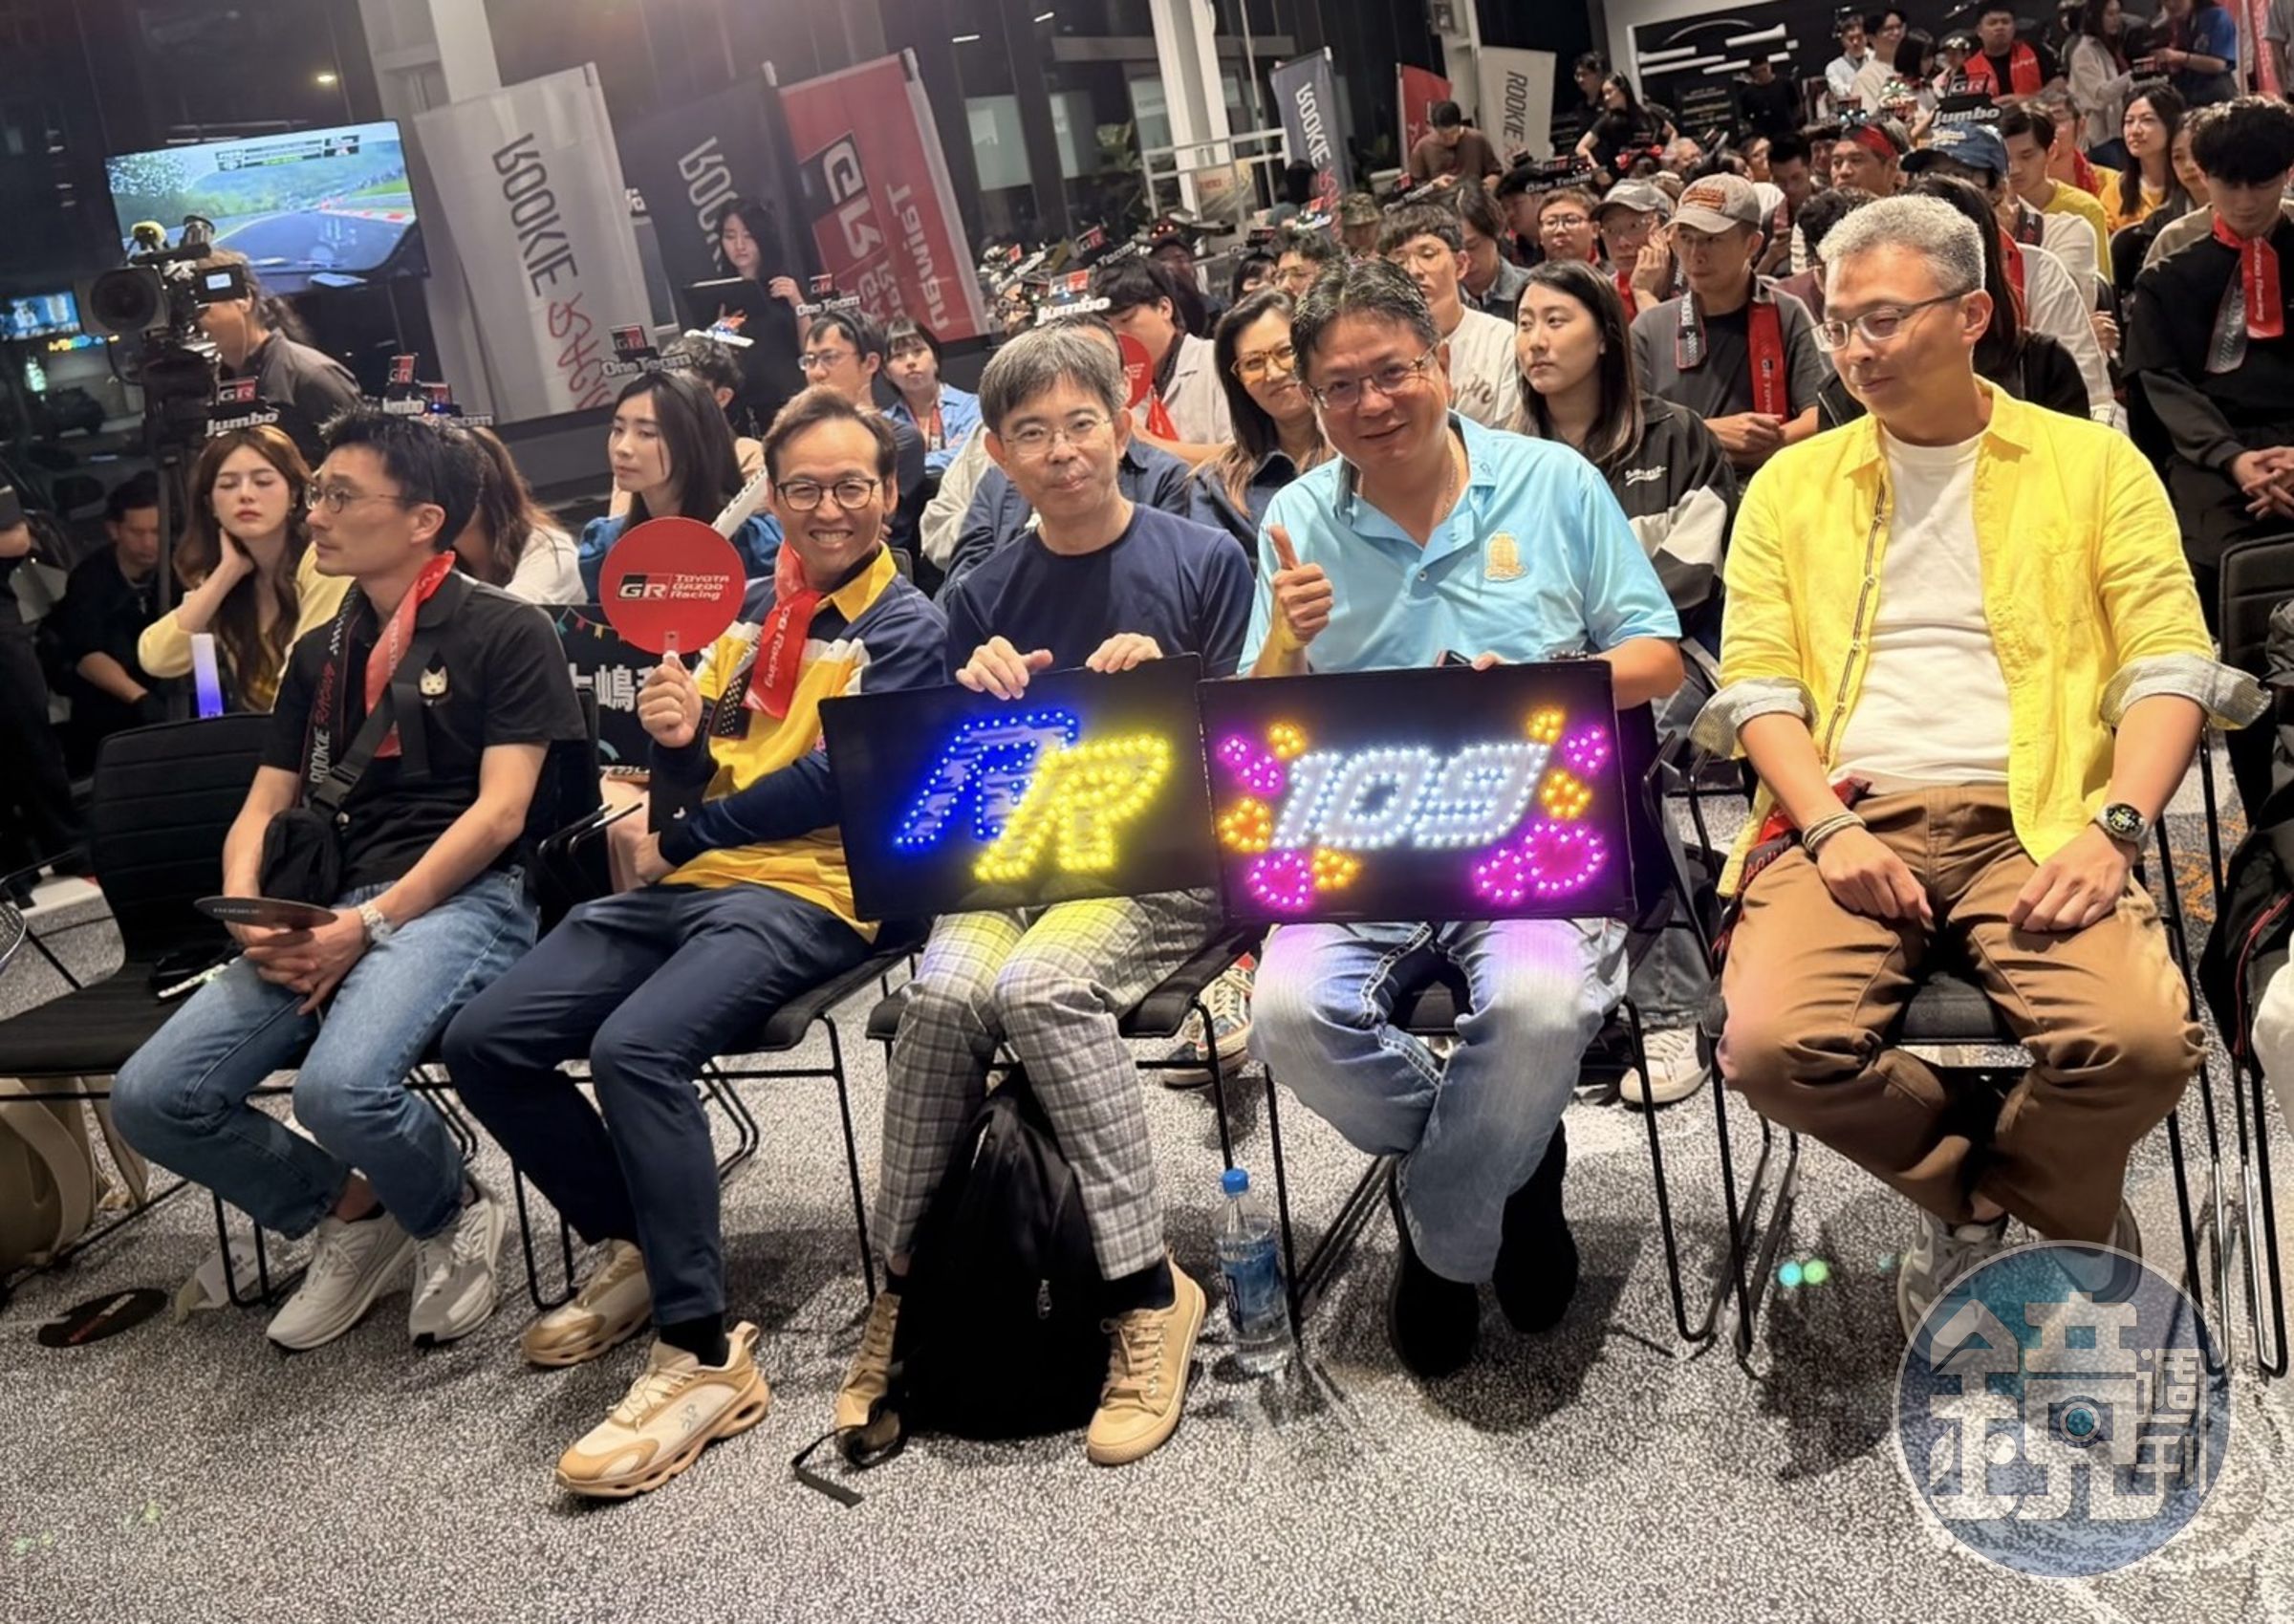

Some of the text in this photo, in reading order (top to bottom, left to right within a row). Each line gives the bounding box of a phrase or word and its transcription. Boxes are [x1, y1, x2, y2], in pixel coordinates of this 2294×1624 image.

[1503, 70, 1528, 142] ROOKIE
[675, 574, 730, 583] TOYOTA
[619, 583, 668, 598] GR
[672, 582, 724, 591] GAZOO
[670, 590, 721, 601] Racing
[1270, 740, 1553, 849] 109
